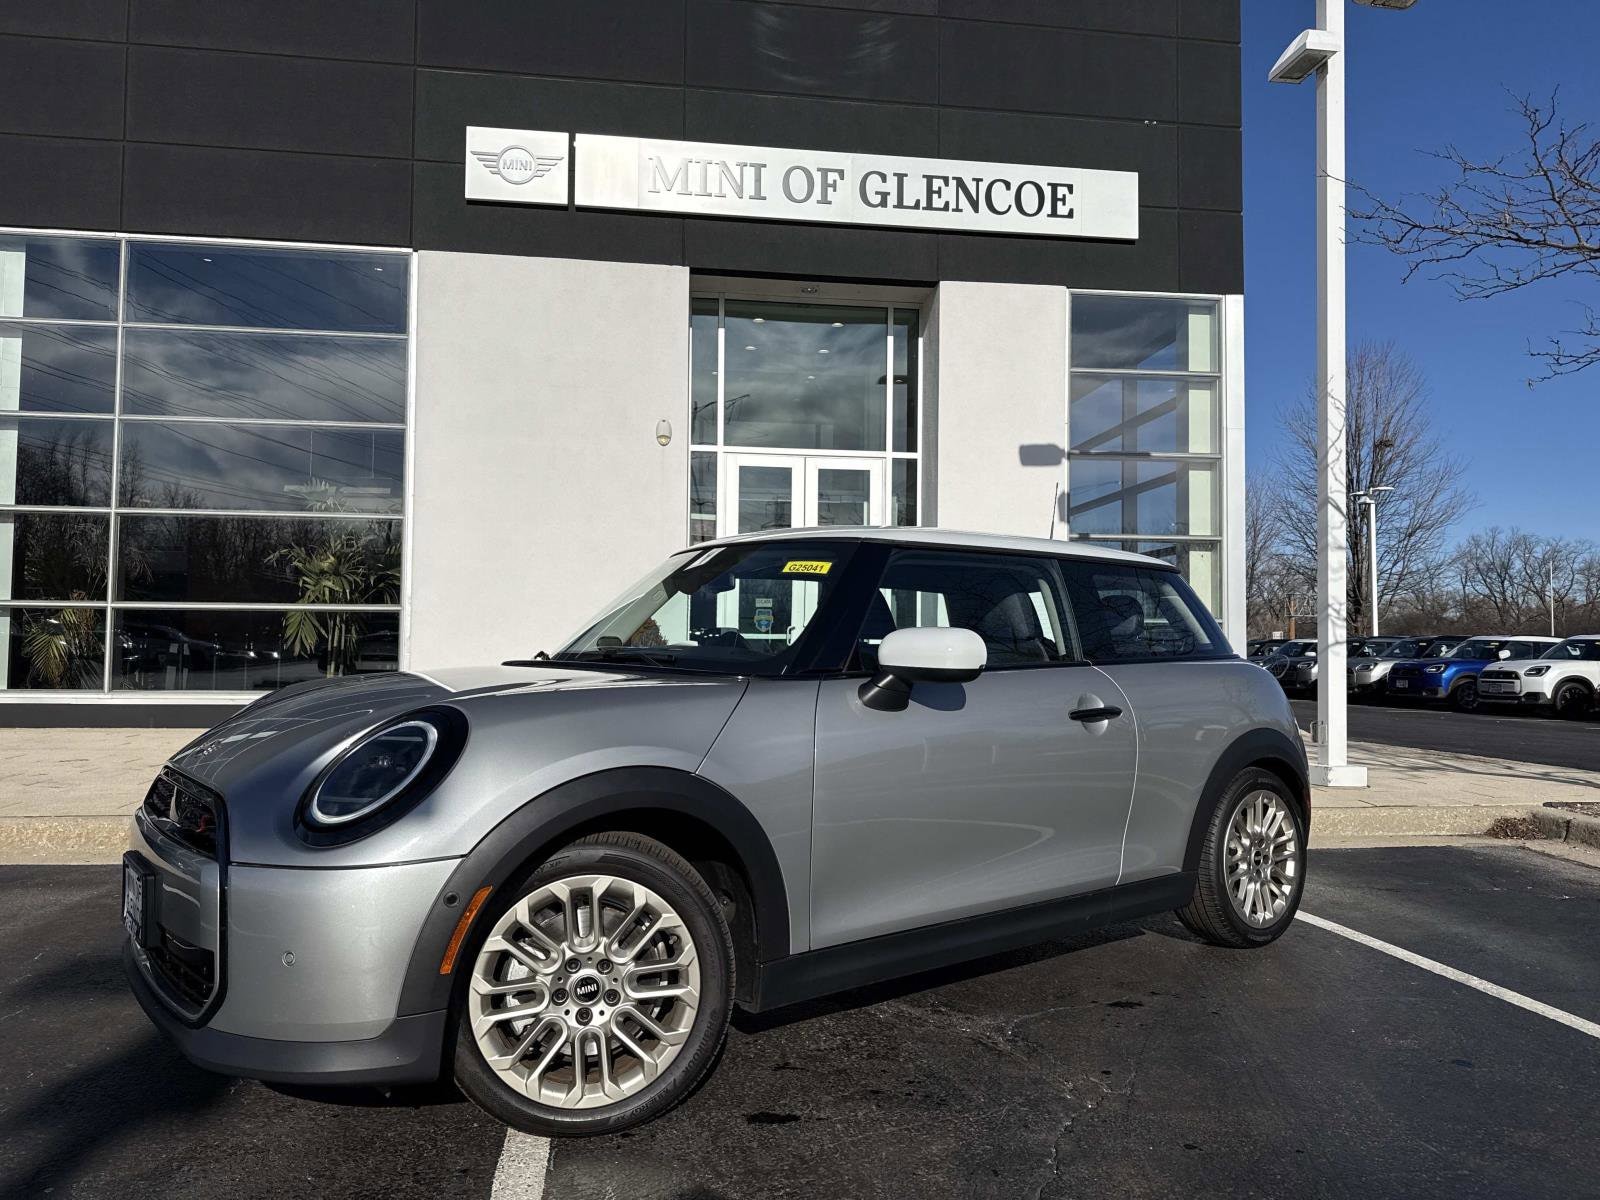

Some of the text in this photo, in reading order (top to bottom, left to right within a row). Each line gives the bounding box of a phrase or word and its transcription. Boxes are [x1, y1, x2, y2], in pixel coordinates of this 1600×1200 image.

[502, 158, 532, 171] MINI
[648, 155, 1074, 219] MINI OF GLENCOE
[788, 563, 825, 573] G25041
[576, 983, 598, 995] MINI
